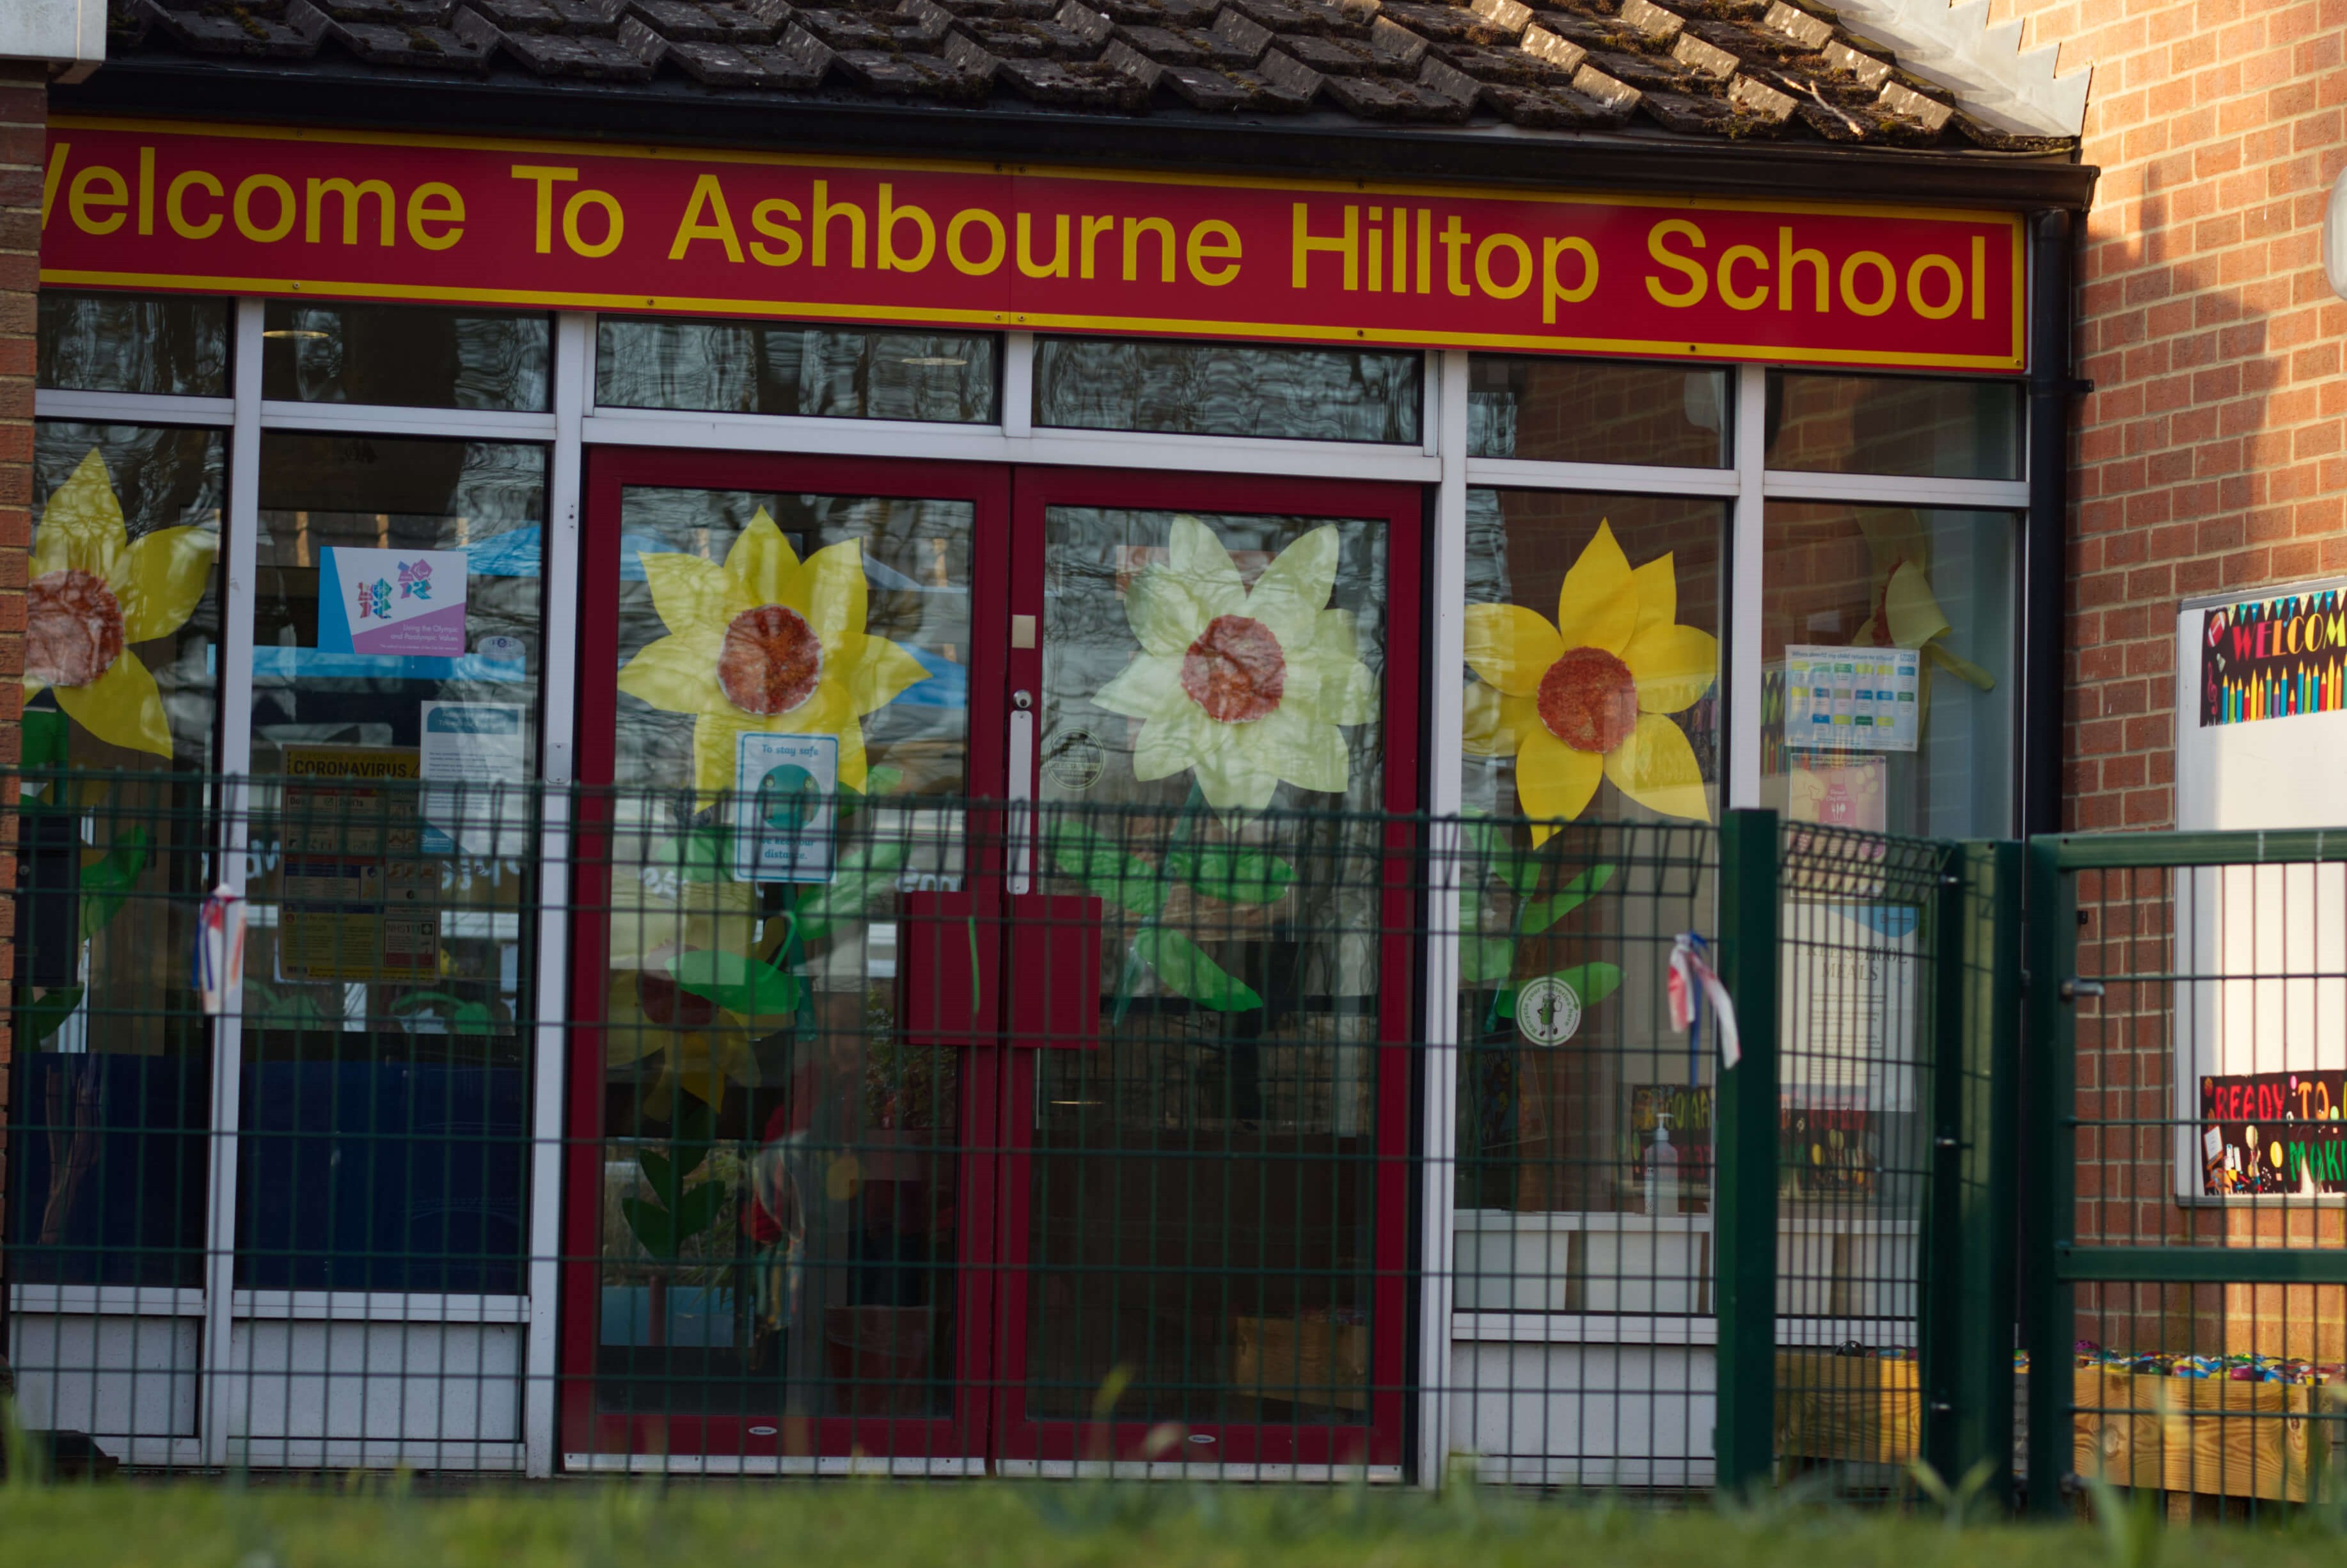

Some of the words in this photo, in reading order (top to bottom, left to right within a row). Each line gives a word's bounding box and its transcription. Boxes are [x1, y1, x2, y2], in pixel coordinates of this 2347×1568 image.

[511, 165, 624, 258] To
[668, 174, 1242, 287] Ashbourne
[1292, 203, 1599, 324] Hilltop
[1646, 219, 1985, 319] School
[763, 744, 772, 754] To
[776, 746, 796, 757] stay
[800, 747, 819, 759] safe
[294, 760, 407, 777] CORONAVIRUS
[764, 848, 808, 860] distae.
[2215, 1083, 2286, 1121] READY
[2298, 1081, 2330, 1121] TO
